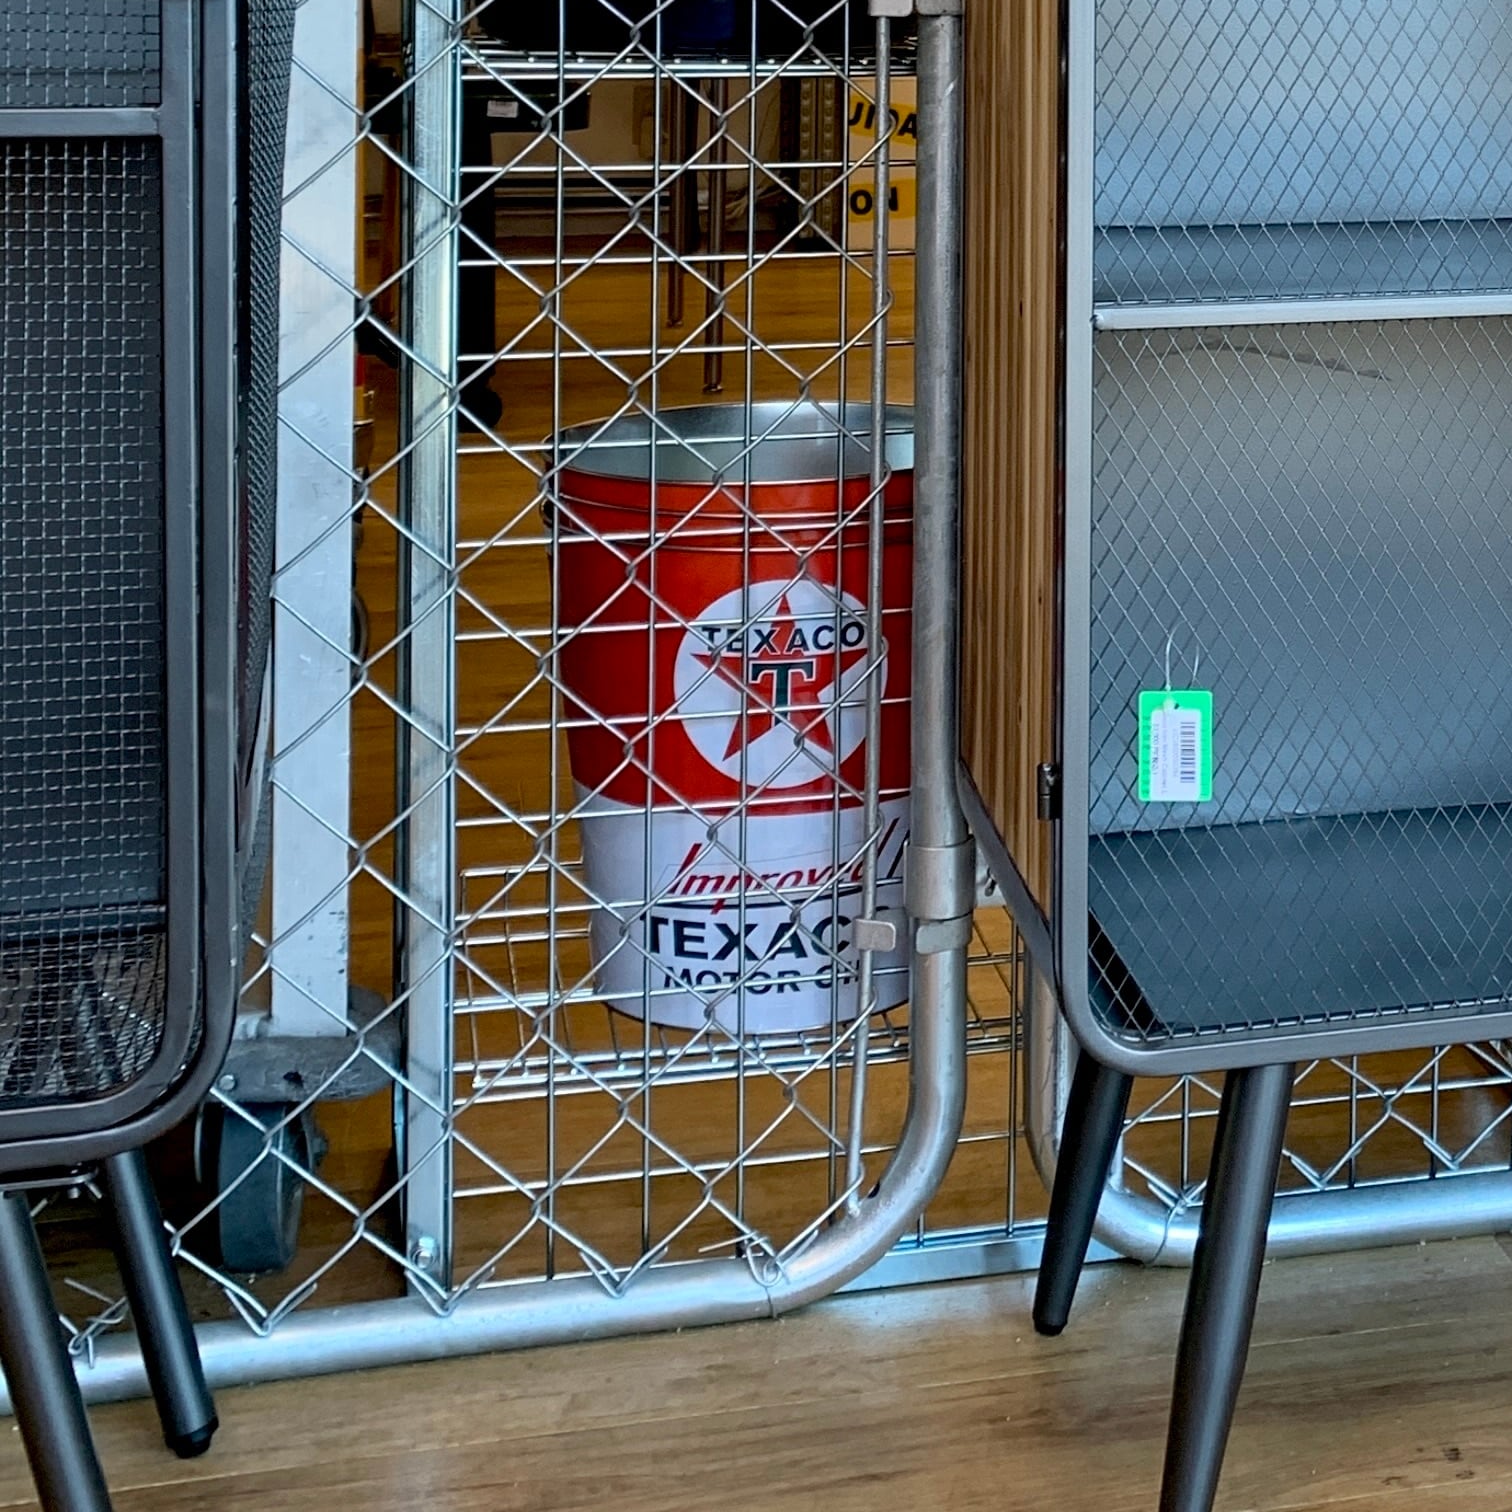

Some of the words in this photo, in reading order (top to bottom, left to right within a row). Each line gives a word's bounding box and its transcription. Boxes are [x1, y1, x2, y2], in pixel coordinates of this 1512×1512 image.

[701, 620, 867, 656] TEXACO
[749, 658, 817, 727] T
[640, 912, 860, 962] TEXAC
[663, 965, 802, 996] MOTOR
